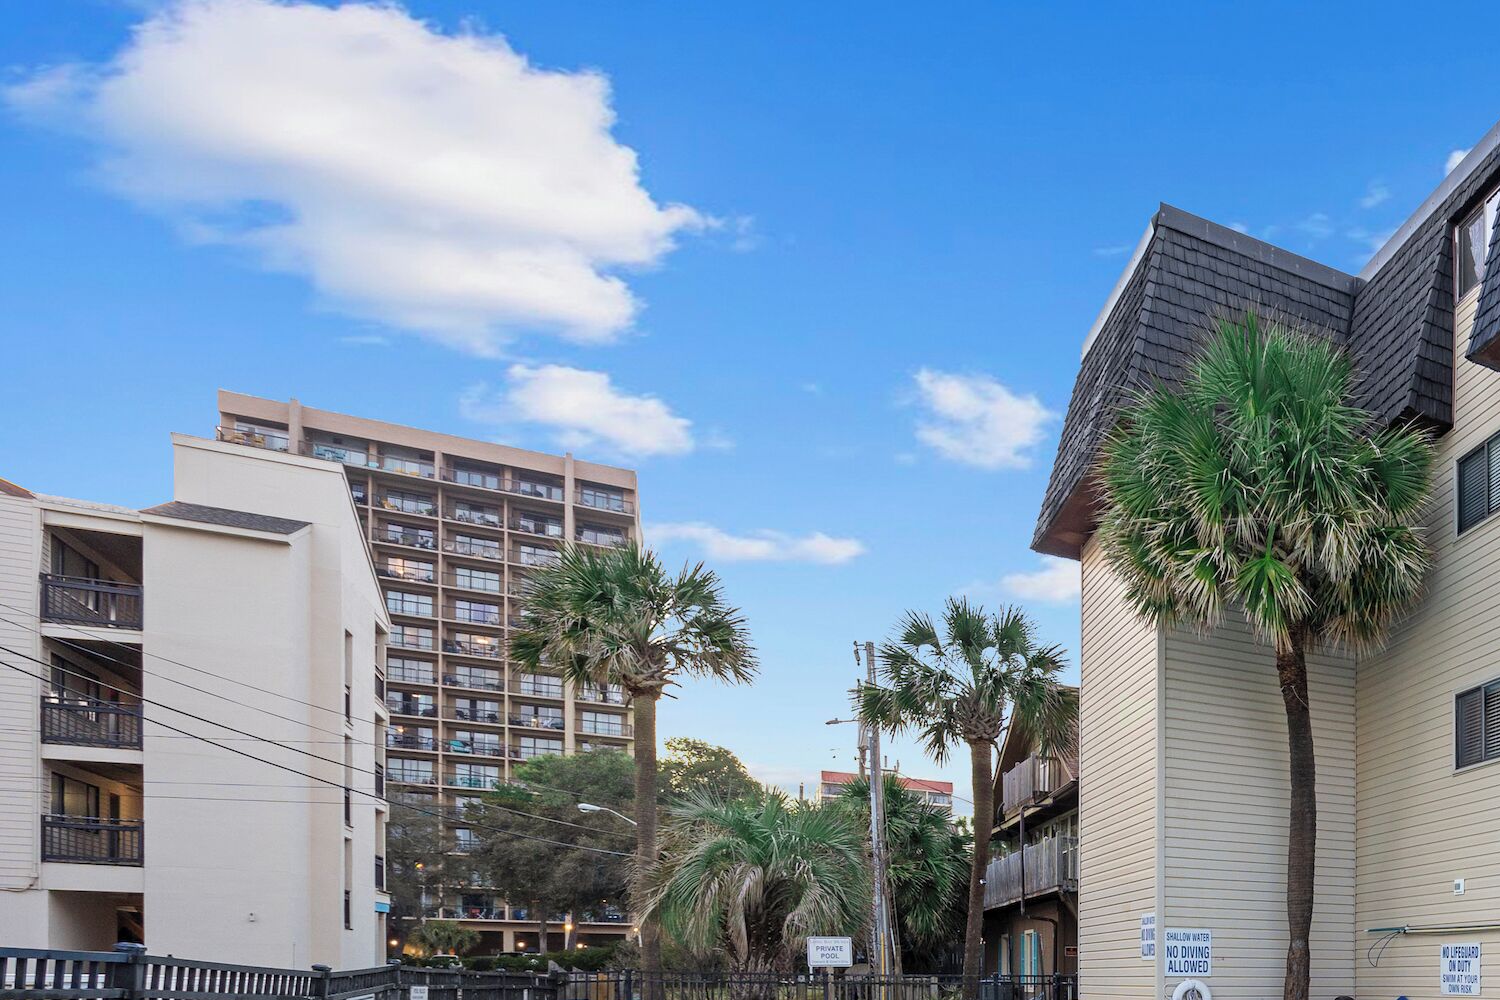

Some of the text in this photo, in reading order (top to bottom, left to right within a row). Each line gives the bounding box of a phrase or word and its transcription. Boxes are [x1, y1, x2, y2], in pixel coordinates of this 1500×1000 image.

[1166, 932, 1210, 942] SHALLOW WATER
[1166, 945, 1210, 959] NO DIVING
[1442, 946, 1479, 958] NO LIFEGUARD
[1167, 960, 1209, 973] ALLOWED
[1449, 960, 1471, 972] ON DUTY
[1457, 975, 1463, 983] AT
[1464, 975, 1478, 983] YOUR
[1449, 984, 1472, 993] OWN RISK
